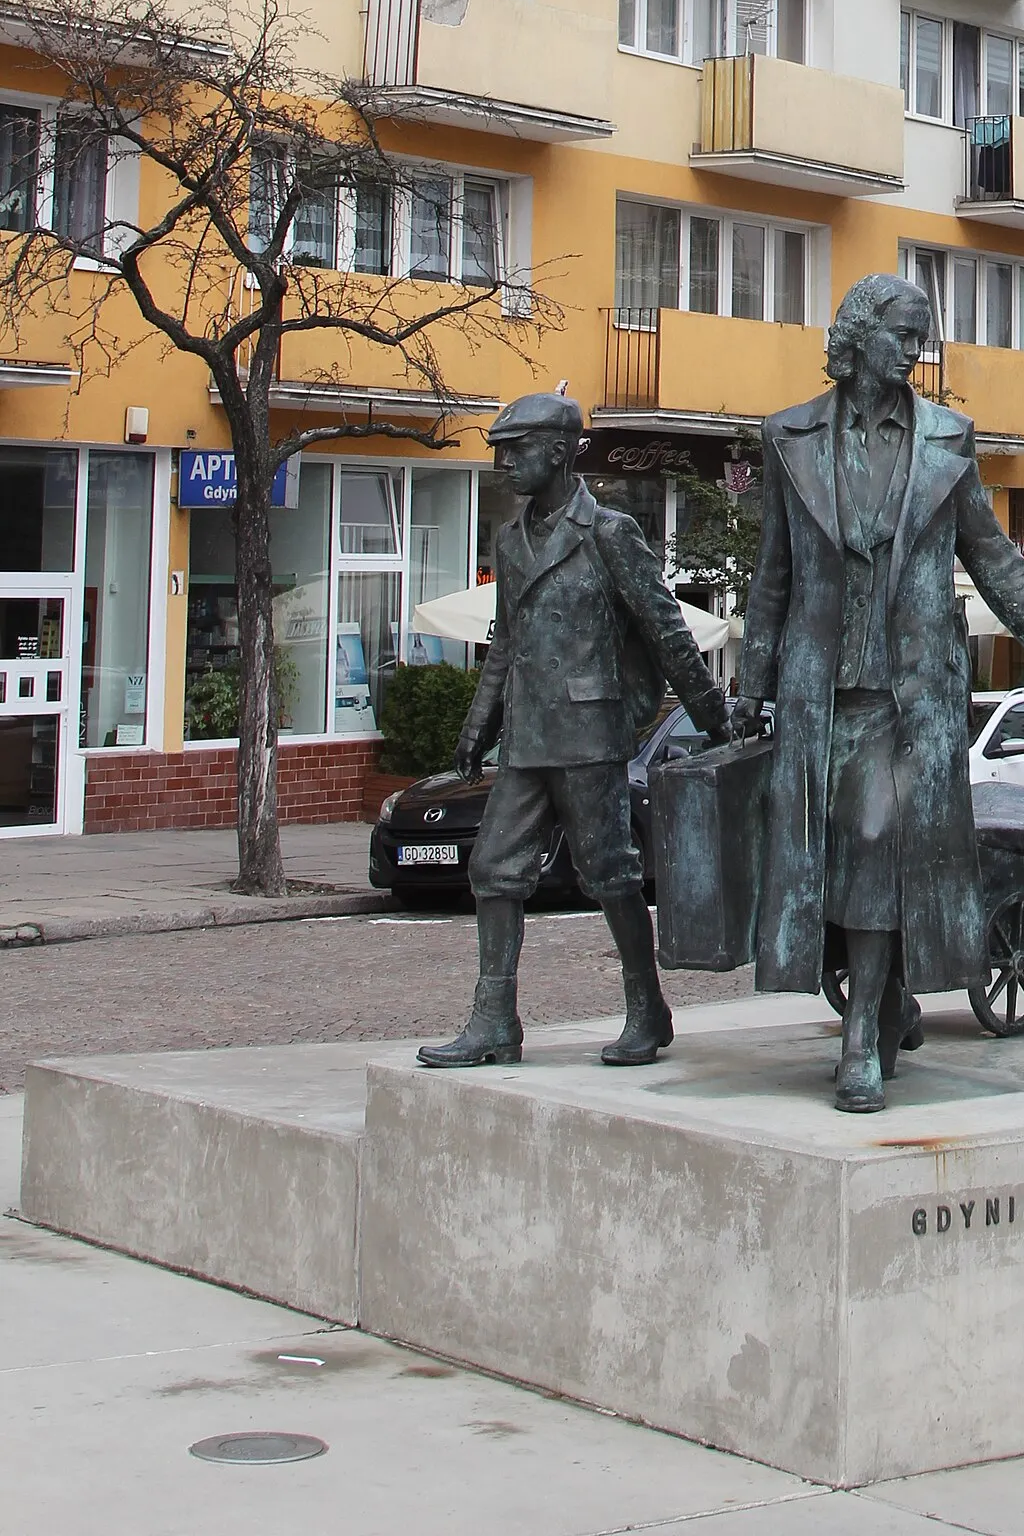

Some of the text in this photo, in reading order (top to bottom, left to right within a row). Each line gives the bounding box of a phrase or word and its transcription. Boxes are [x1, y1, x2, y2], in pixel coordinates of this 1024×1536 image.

[608, 440, 690, 472] coffee
[204, 485, 237, 501] Gdyń
[404, 846, 456, 861] GD 328SU
